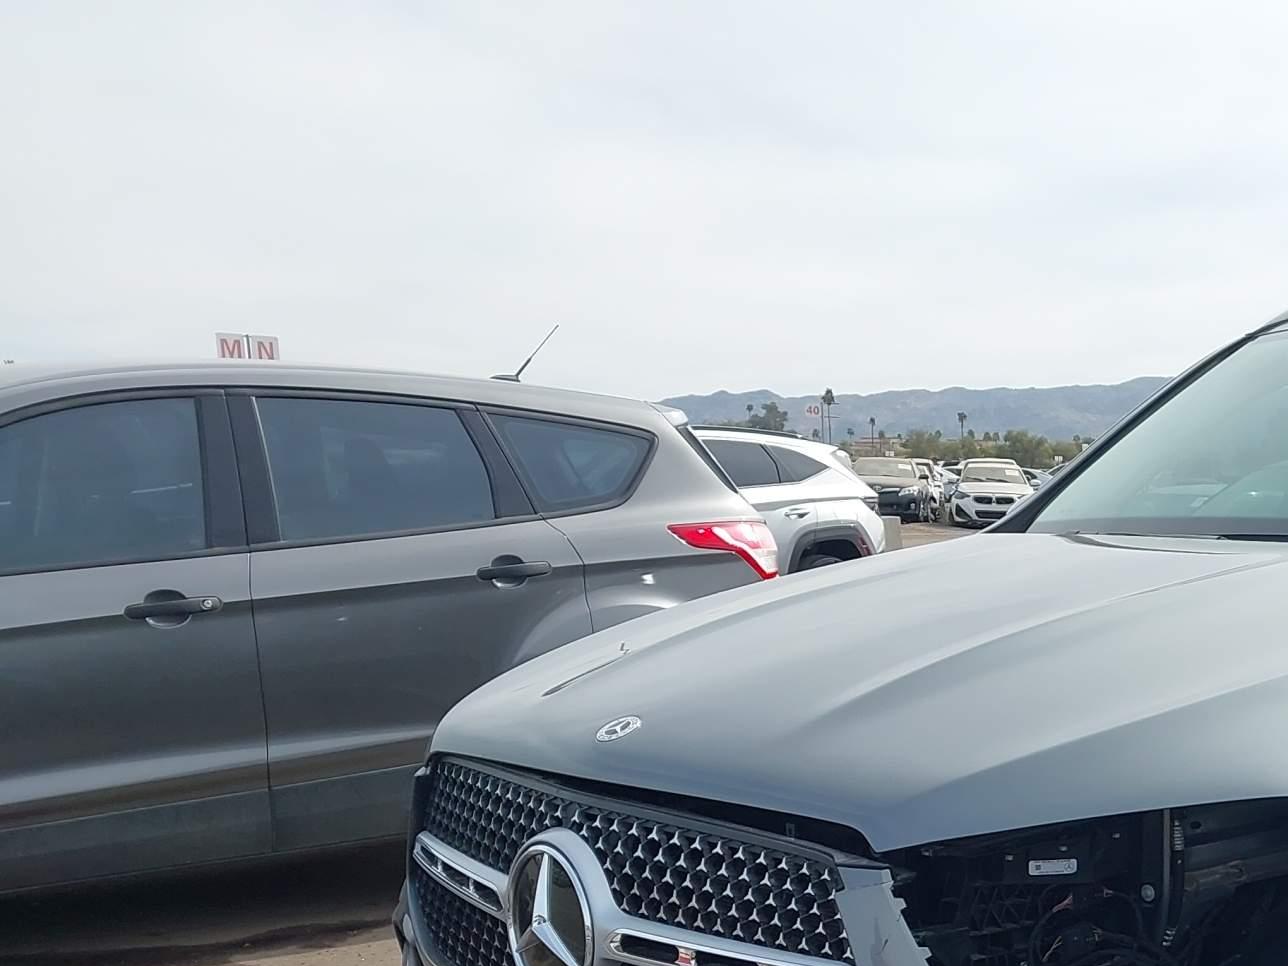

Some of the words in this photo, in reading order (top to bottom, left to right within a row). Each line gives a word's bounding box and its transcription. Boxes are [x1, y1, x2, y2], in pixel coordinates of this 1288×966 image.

[219, 338, 242, 359] M
[256, 341, 275, 360] N
[806, 405, 820, 415] 40
